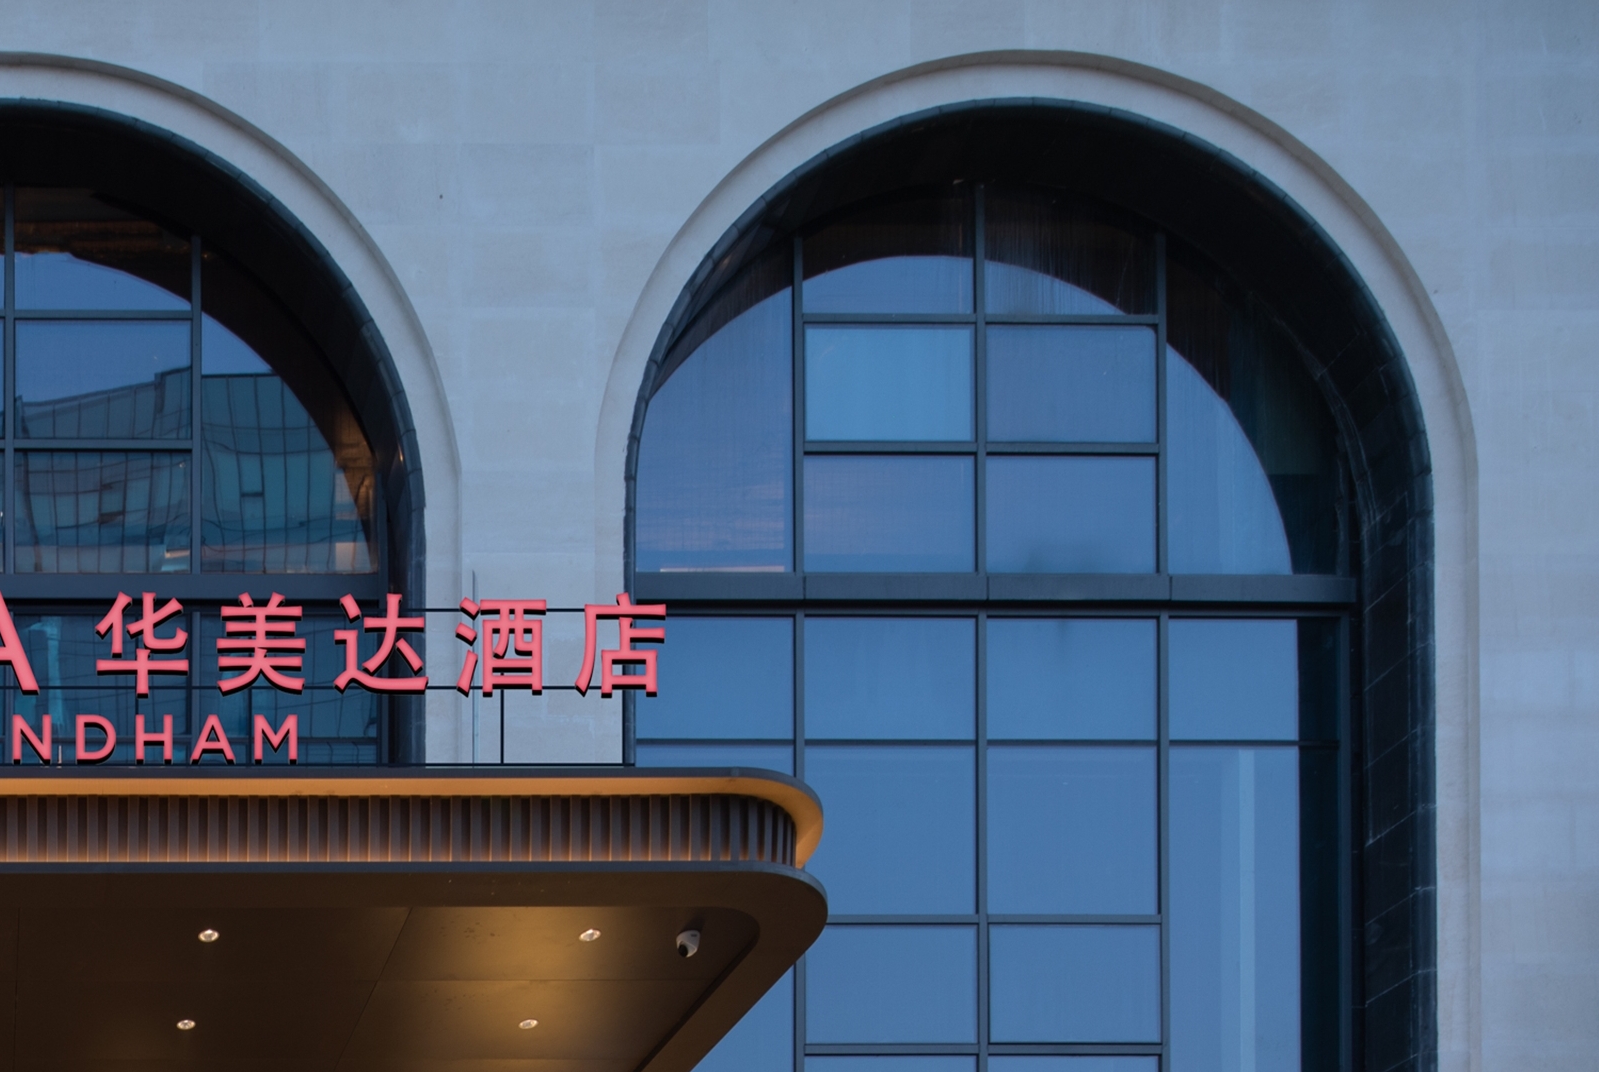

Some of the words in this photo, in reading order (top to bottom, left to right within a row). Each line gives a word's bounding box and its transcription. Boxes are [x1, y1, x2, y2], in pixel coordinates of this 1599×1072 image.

[95, 592, 667, 697] 华美达酒店
